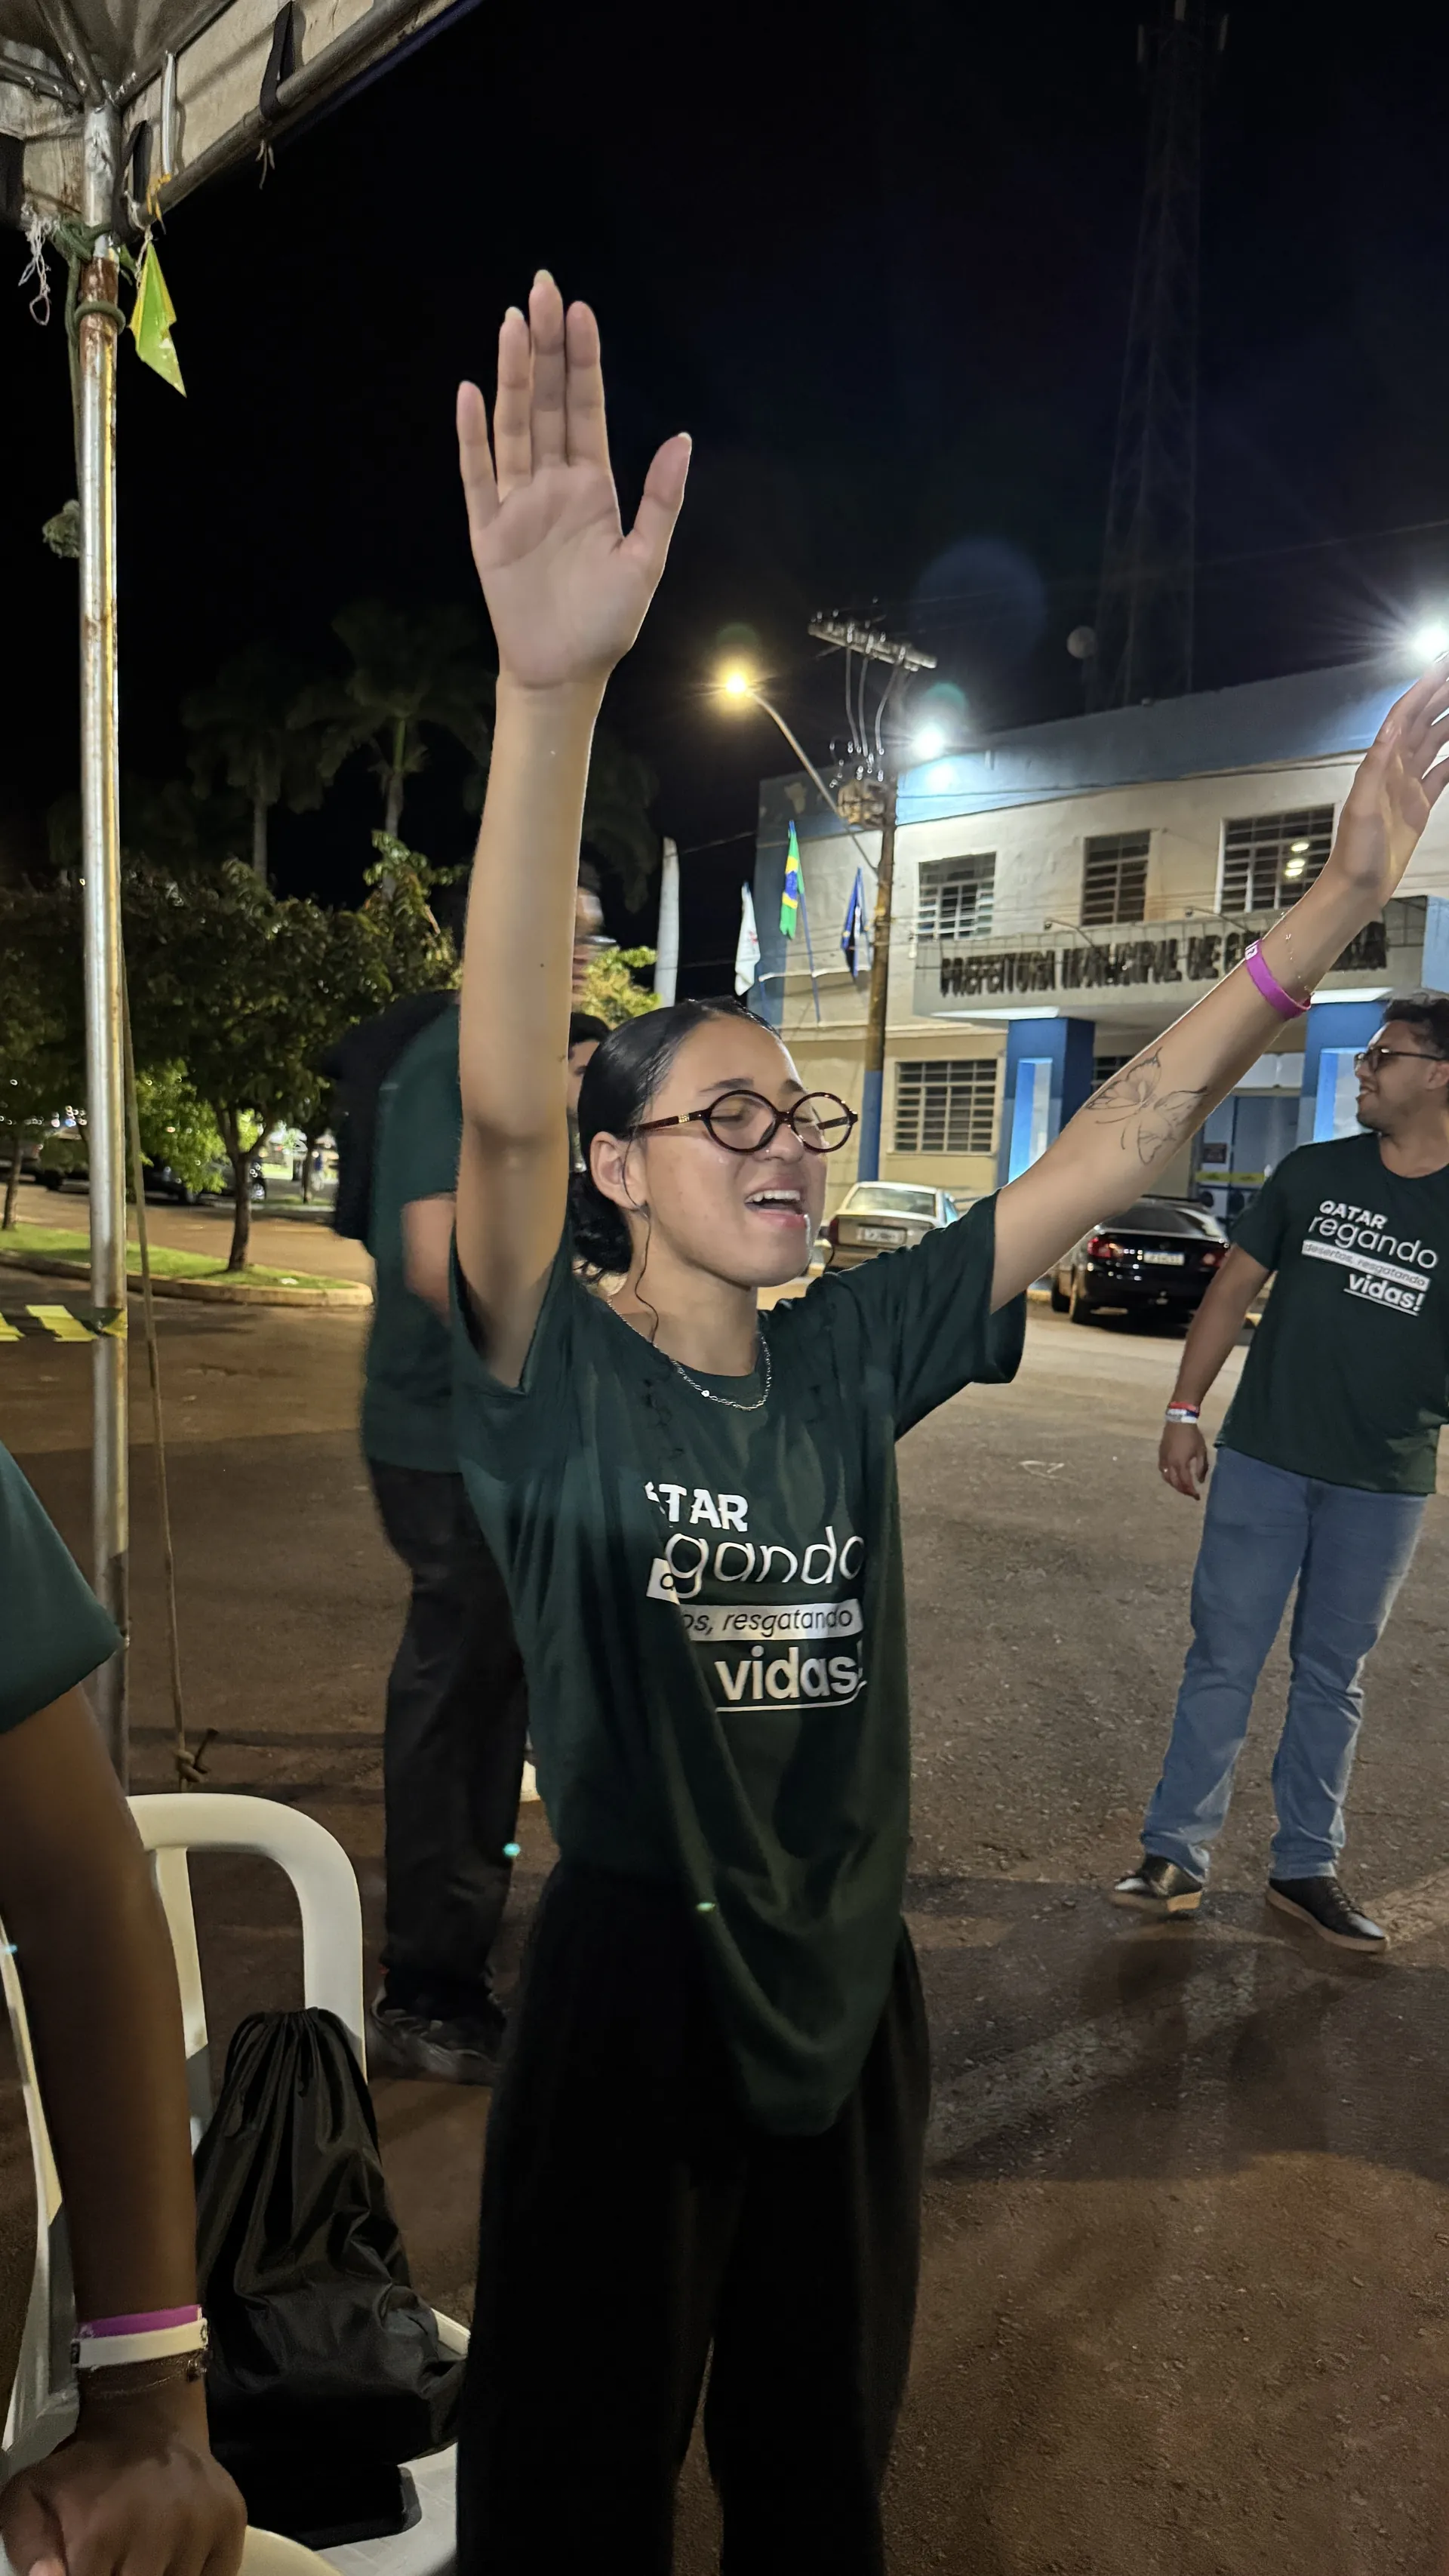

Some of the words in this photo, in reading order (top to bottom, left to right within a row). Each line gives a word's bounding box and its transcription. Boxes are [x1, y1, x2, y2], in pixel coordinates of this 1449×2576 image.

[941, 949, 1057, 997] PREFEITURA
[1319, 1200, 1388, 1230] QATAR
[1308, 1216, 1438, 1269] regando
[1349, 1273, 1426, 1311] vidas!
[644, 1481, 749, 1532] TAR
[665, 1525, 864, 1599] gando
[722, 1609, 852, 1637] resgatando
[714, 1645, 863, 1700] vidas
